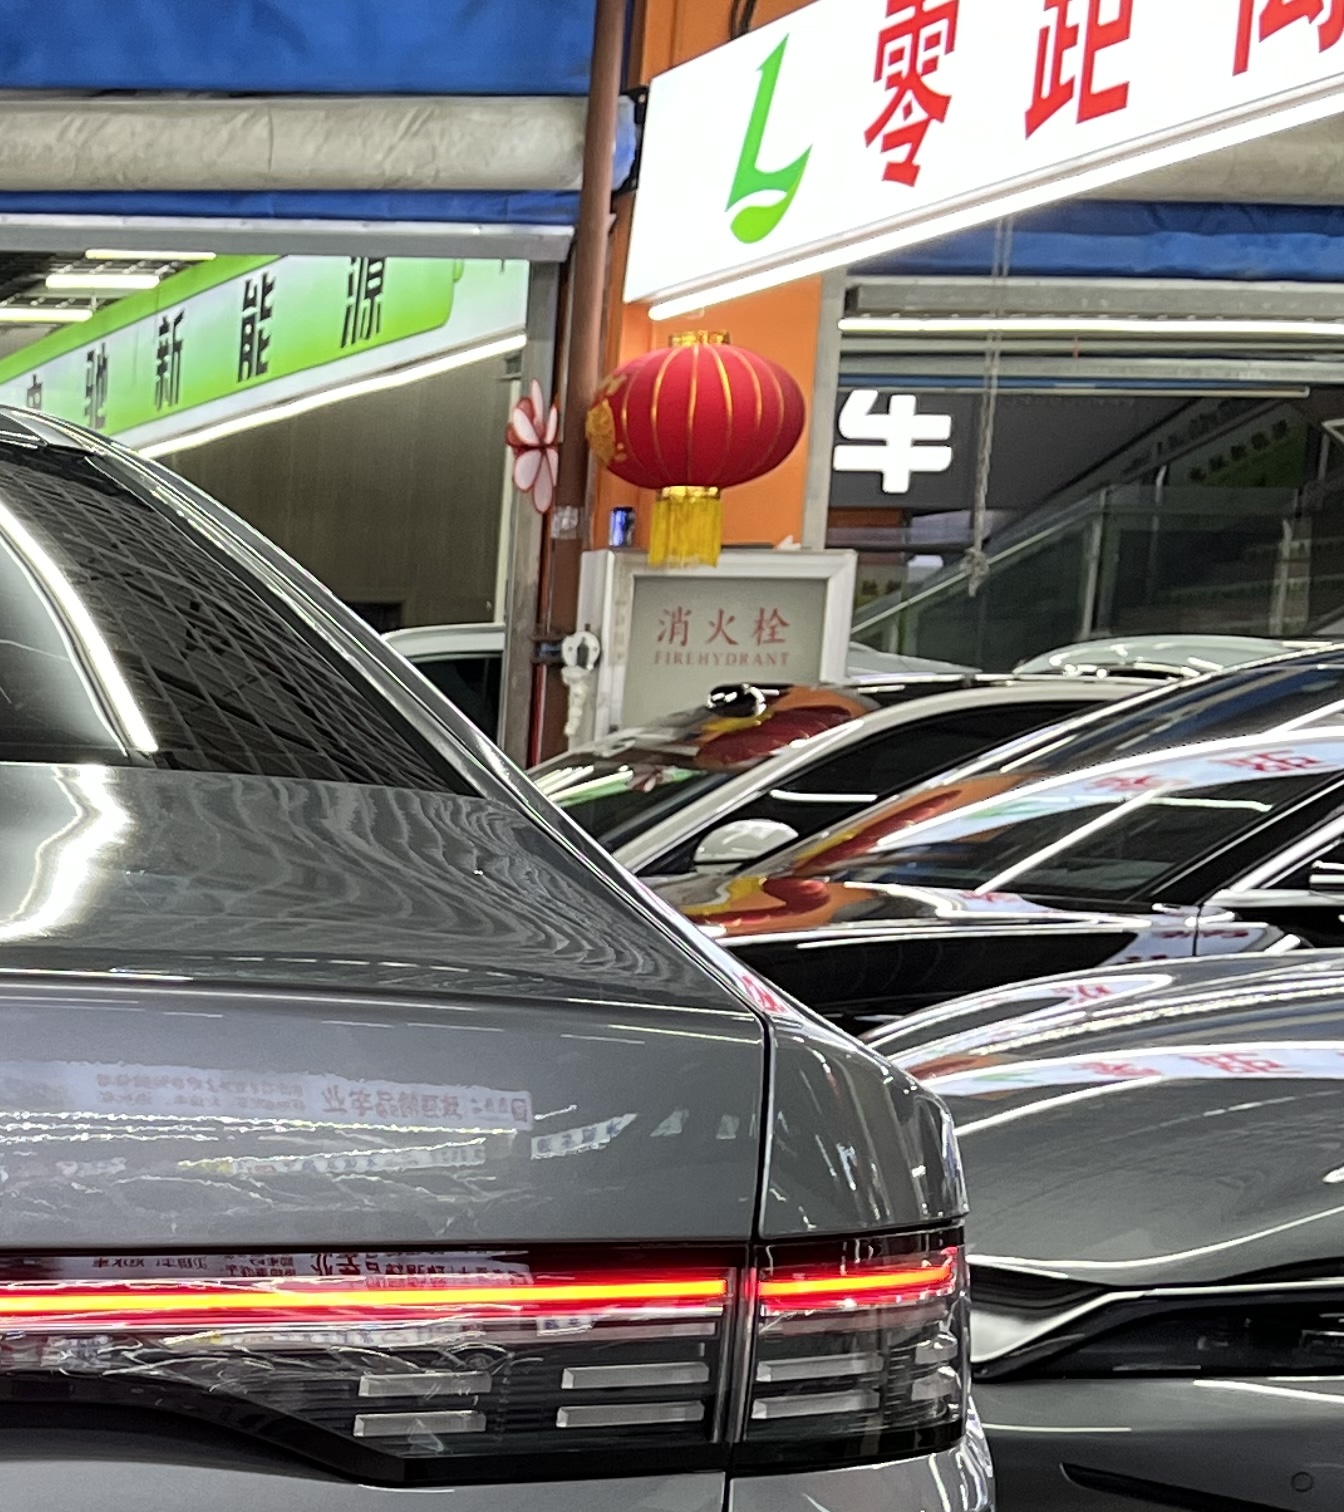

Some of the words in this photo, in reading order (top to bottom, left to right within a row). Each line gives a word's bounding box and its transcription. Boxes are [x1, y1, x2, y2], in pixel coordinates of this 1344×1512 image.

[864, 0, 1344, 187] 零距
[657, 606, 790, 646] 消火栓
